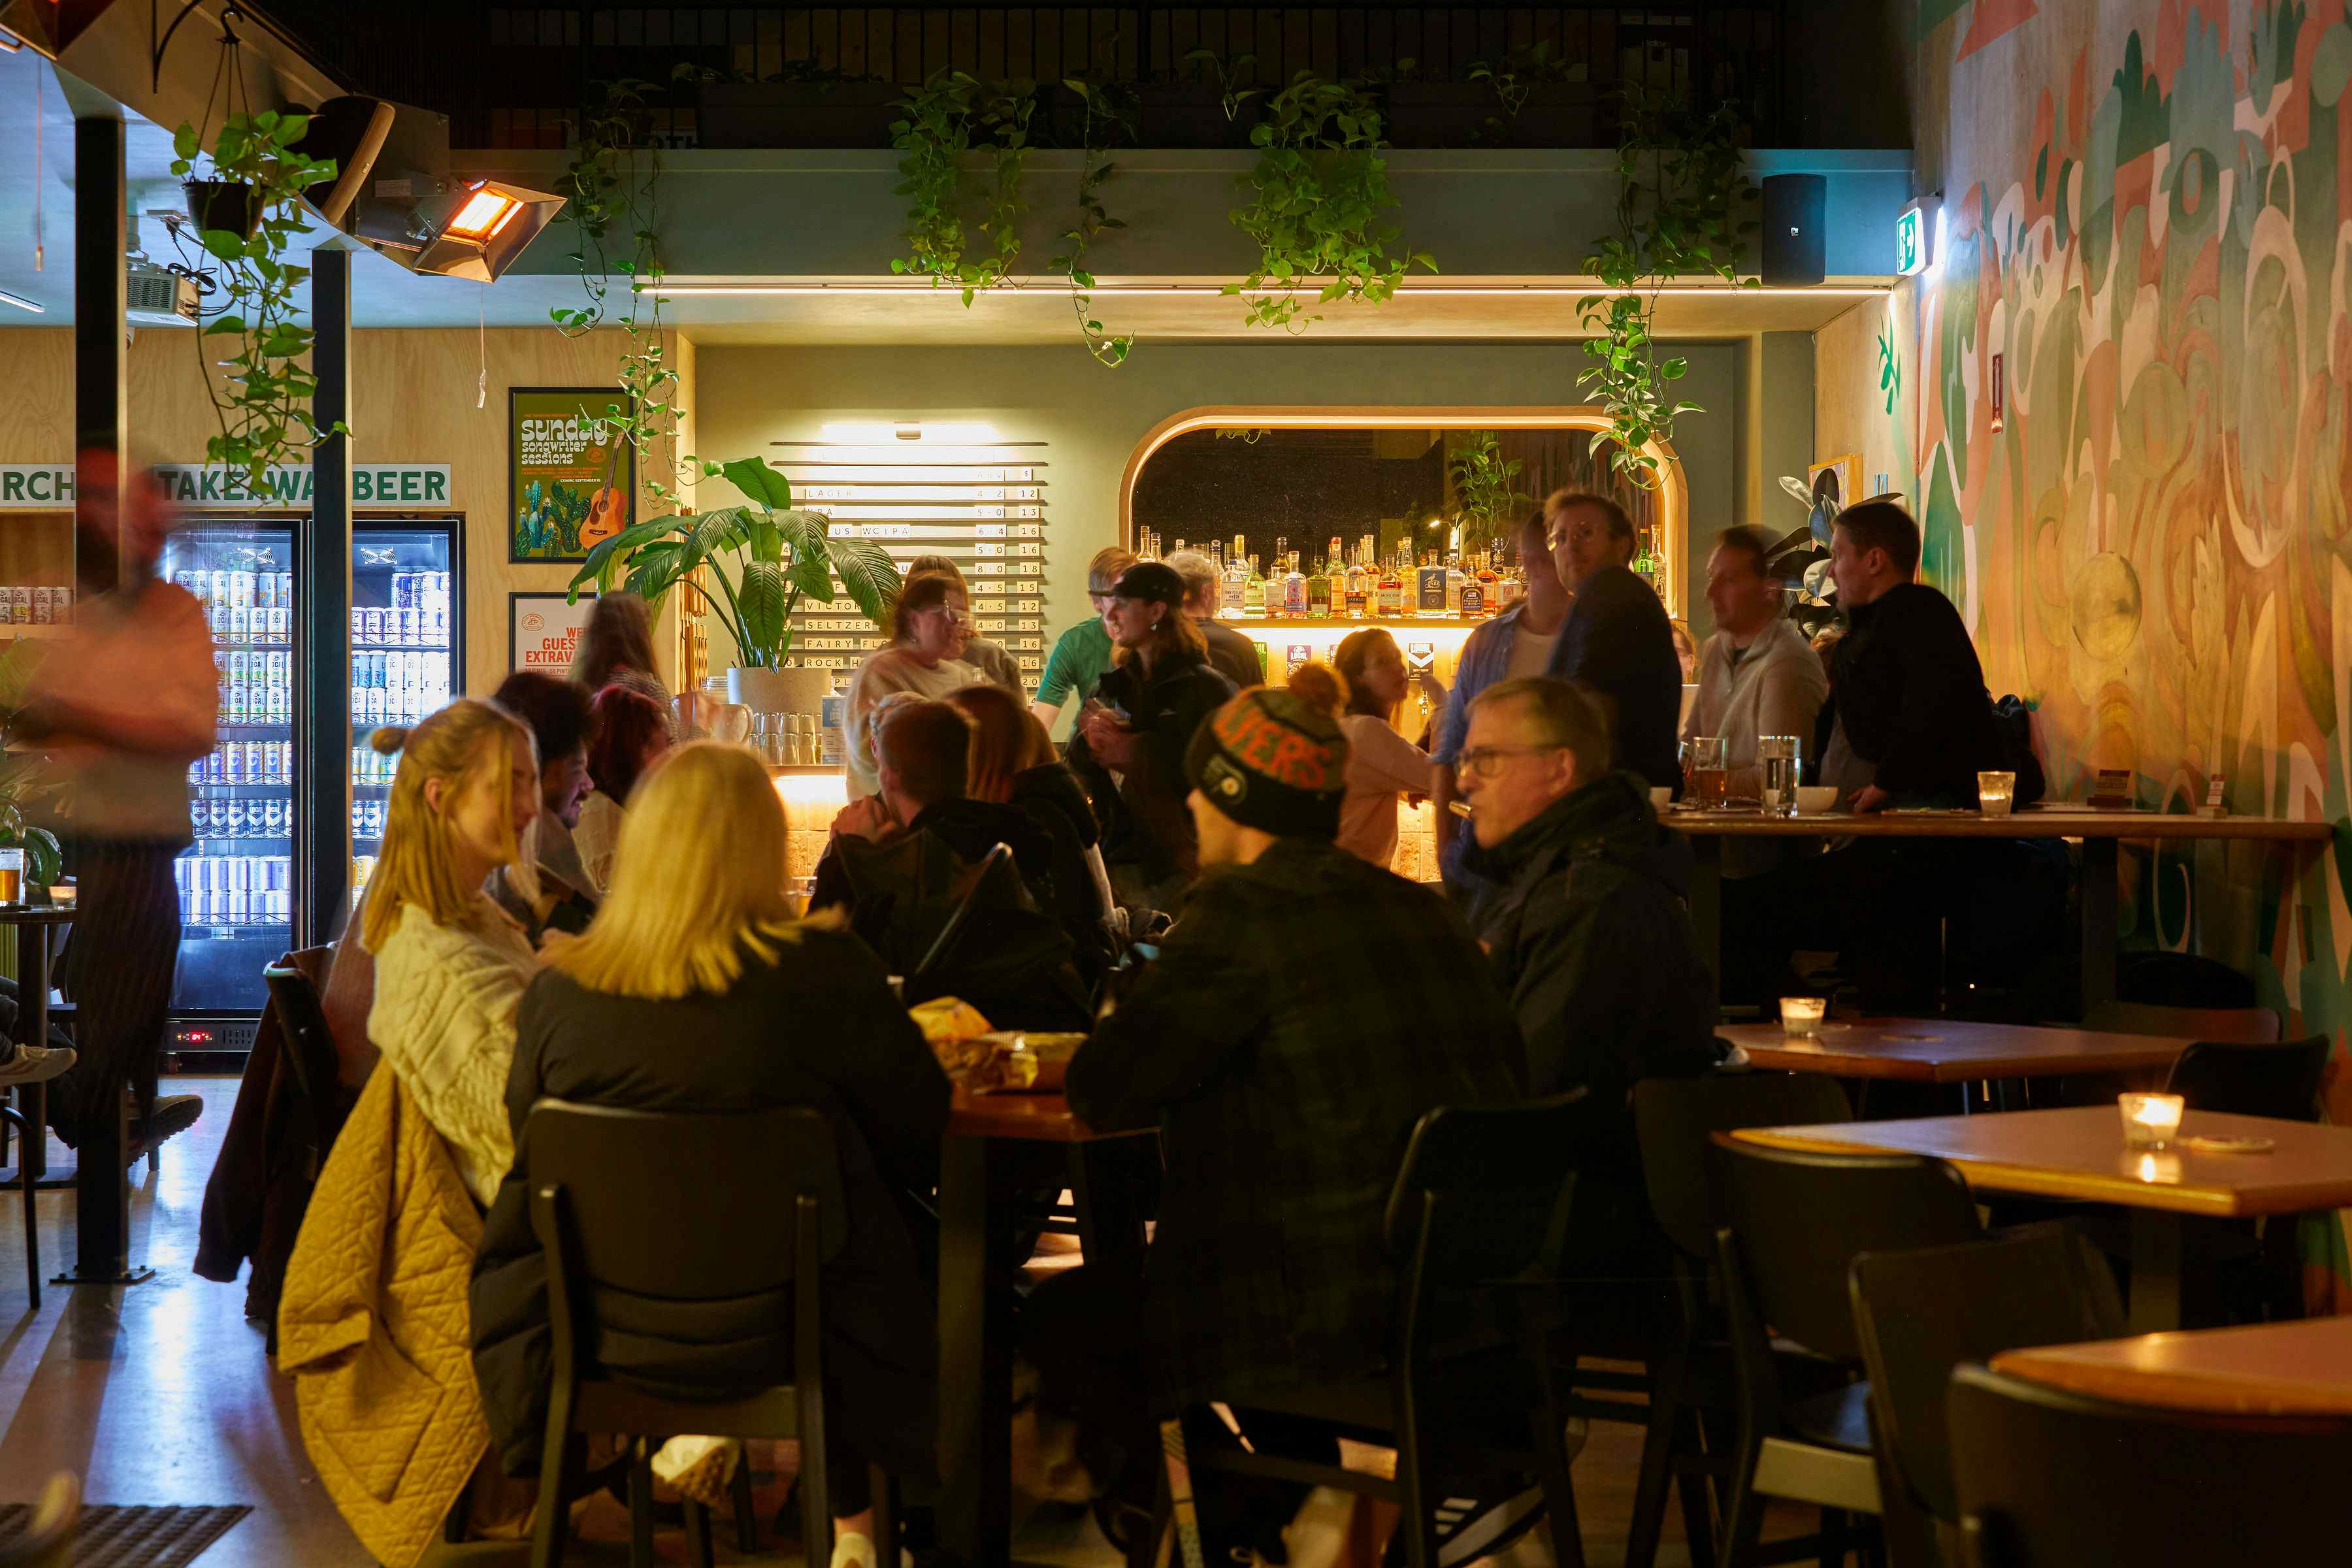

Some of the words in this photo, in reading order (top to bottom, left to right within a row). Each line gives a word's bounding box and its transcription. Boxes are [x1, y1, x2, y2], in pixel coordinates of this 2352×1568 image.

[522, 439, 587, 454] songwriter
[521, 452, 574, 465] sessions
[353, 471, 446, 500] BEER
